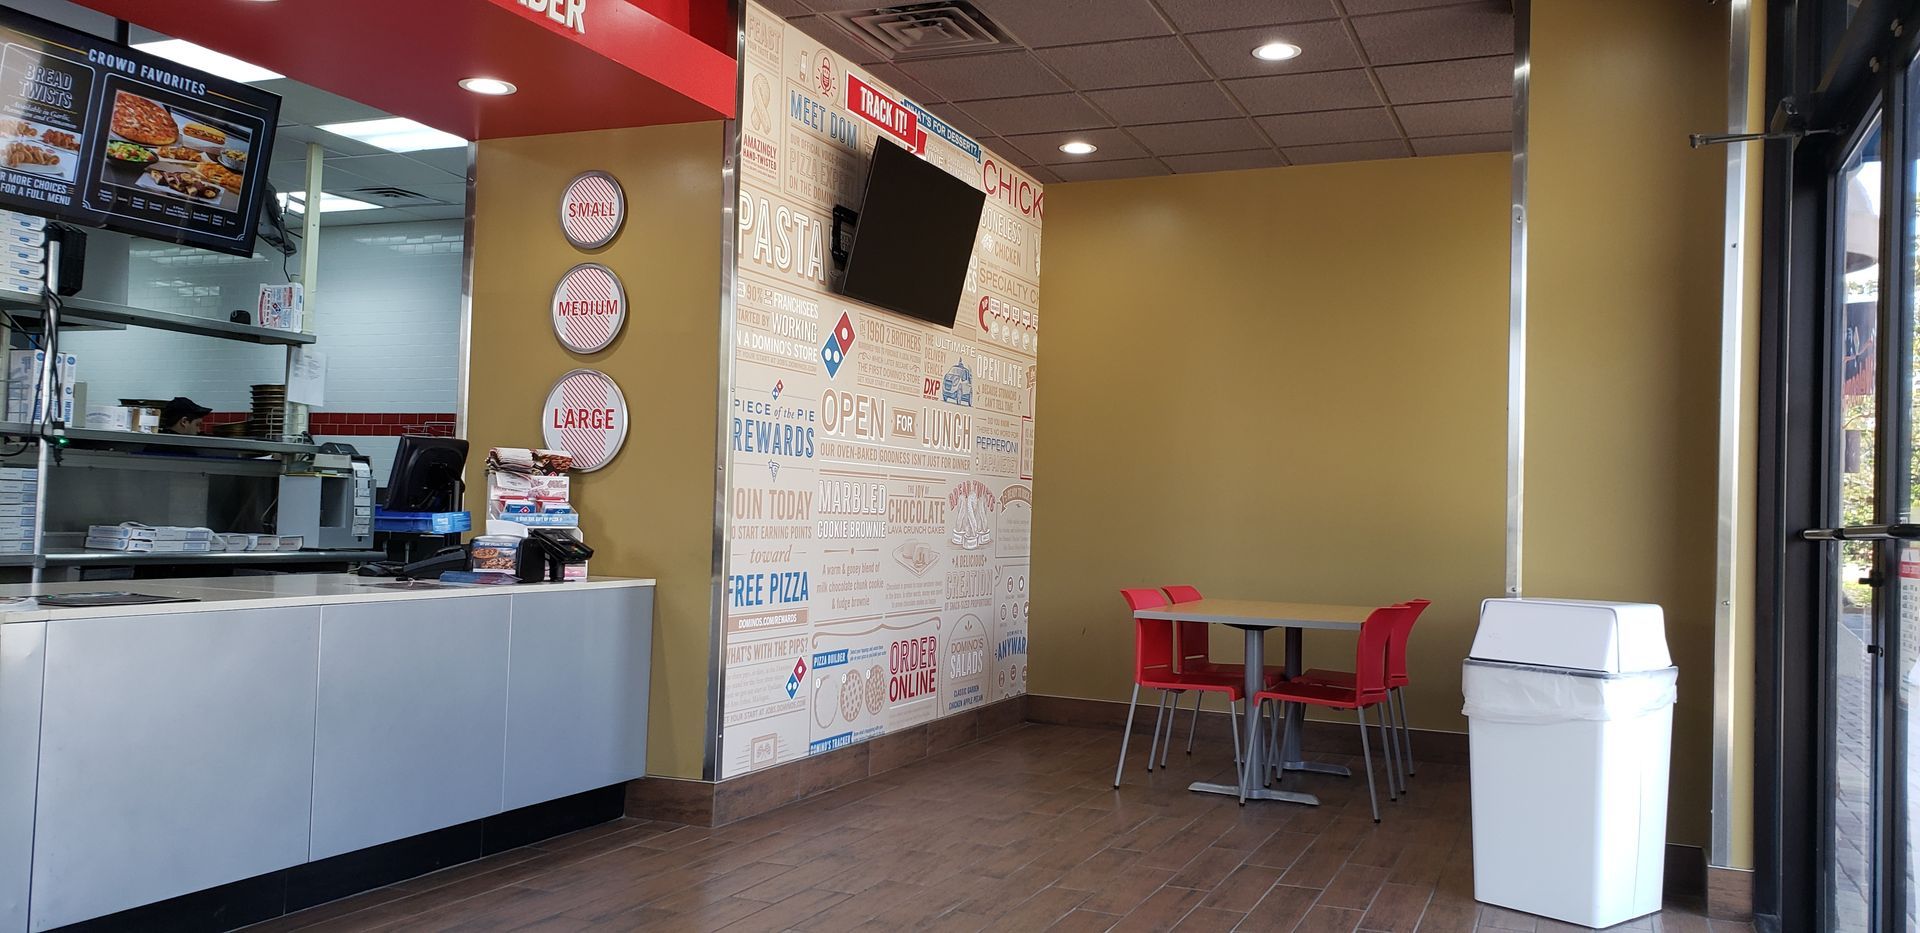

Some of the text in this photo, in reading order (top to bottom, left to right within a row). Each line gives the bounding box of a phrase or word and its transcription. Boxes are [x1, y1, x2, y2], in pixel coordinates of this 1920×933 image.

[24, 63, 73, 91] BREAD
[88, 49, 207, 96] CROWD FAVORITES
[19, 79, 73, 109] TWISTS
[791, 90, 857, 150] MEET DOM
[860, 86, 908, 137] TRACK IT!
[743, 133, 777, 160] AMAZINGLY
[932, 118, 947, 137] FOR
[947, 129, 978, 156] DESSERT?
[743, 148, 777, 171] HAND-TWISTED
[790, 147, 818, 182] PIZZA
[0, 183, 71, 206] FOR A FULL MENU
[8, 173, 33, 187] MORE
[34, 179, 67, 194] CHOICES
[790, 175, 811, 197] ON THE
[984, 160, 1043, 220] CHICK
[568, 201, 616, 218] SMALL
[738, 190, 825, 284] PASTA
[981, 206, 1022, 246] BONELESS
[995, 241, 1021, 267] CHICKEN
[747, 285, 762, 303] 90%
[980, 268, 1028, 301] SPECIALTY
[558, 299, 618, 317] MEDIUM
[773, 291, 818, 319] FRANCHISEES
[772, 312, 817, 343] WORKING
[867, 320, 885, 344] 1960
[886, 328, 891, 343] 2
[892, 329, 921, 352] BROTHERS
[744, 331, 750, 346] A
[752, 334, 792, 355] DOMINO'S
[794, 344, 818, 362] STORE
[924, 347, 947, 364] DELIVERY
[935, 336, 977, 358] ULTIMATE
[976, 354, 1023, 388] OPEN LATE
[923, 378, 941, 396] DXP
[554, 408, 615, 430] LARGE
[734, 399, 815, 422] PIECE of the PIE
[820, 388, 887, 441] OPEN
[896, 414, 914, 433] FOR
[922, 407, 973, 452] LUNCH
[734, 418, 815, 458] REWARDS
[976, 436, 1018, 455] PEPPERONI
[820, 443, 835, 457] OUR
[837, 445, 878, 462] OVEN-BAKED
[879, 448, 910, 465] GOODNESS
[911, 452, 927, 466] ISN'T
[927, 454, 940, 468] JUST
[941, 455, 951, 469] FOR
[952, 457, 971, 471] DINNER
[732, 488, 813, 520] OIN TODAY
[818, 480, 887, 515] MARBLED
[915, 485, 924, 498] JOY
[889, 499, 945, 523] CHOCOLATE
[739, 526, 758, 539] START
[761, 526, 789, 539] EARNING
[791, 526, 812, 539] POINTS
[817, 521, 887, 539] COOKIE BROWNIE
[888, 526, 945, 535] LAVA CRUNCH CAKES
[750, 545, 792, 563] toward
[827, 565, 841, 575] warm
[728, 572, 808, 607] FREE PIZZA
[829, 581, 854, 592] chocolate
[946, 569, 993, 600] CREATION
[754, 643, 772, 660] WITH
[774, 641, 787, 657] THE
[789, 637, 808, 654] PIPS?
[890, 636, 937, 674] ORDER
[951, 638, 984, 653] DOMINO'S
[814, 655, 827, 667] PIZZA
[951, 650, 983, 679] SALADS
[889, 669, 937, 702] ONLINE
